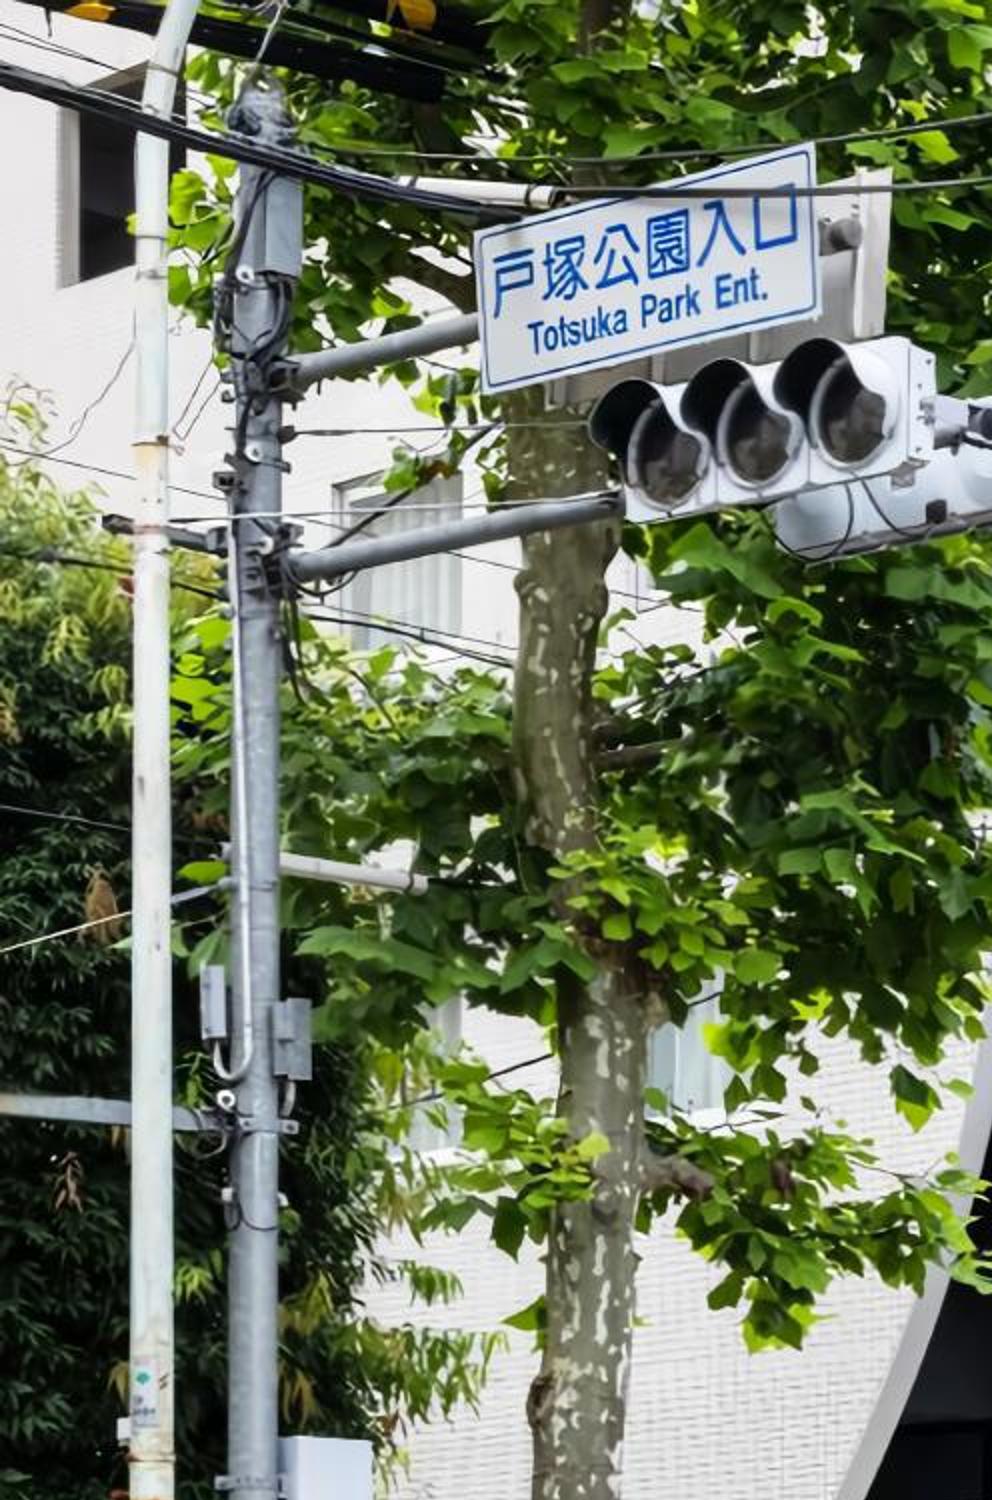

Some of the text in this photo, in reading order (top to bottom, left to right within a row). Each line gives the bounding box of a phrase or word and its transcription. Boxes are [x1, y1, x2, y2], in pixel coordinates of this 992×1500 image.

[493, 183, 798, 319] 戸塚公園入口
[527, 267, 768, 354] Totsuka Park Ent.
